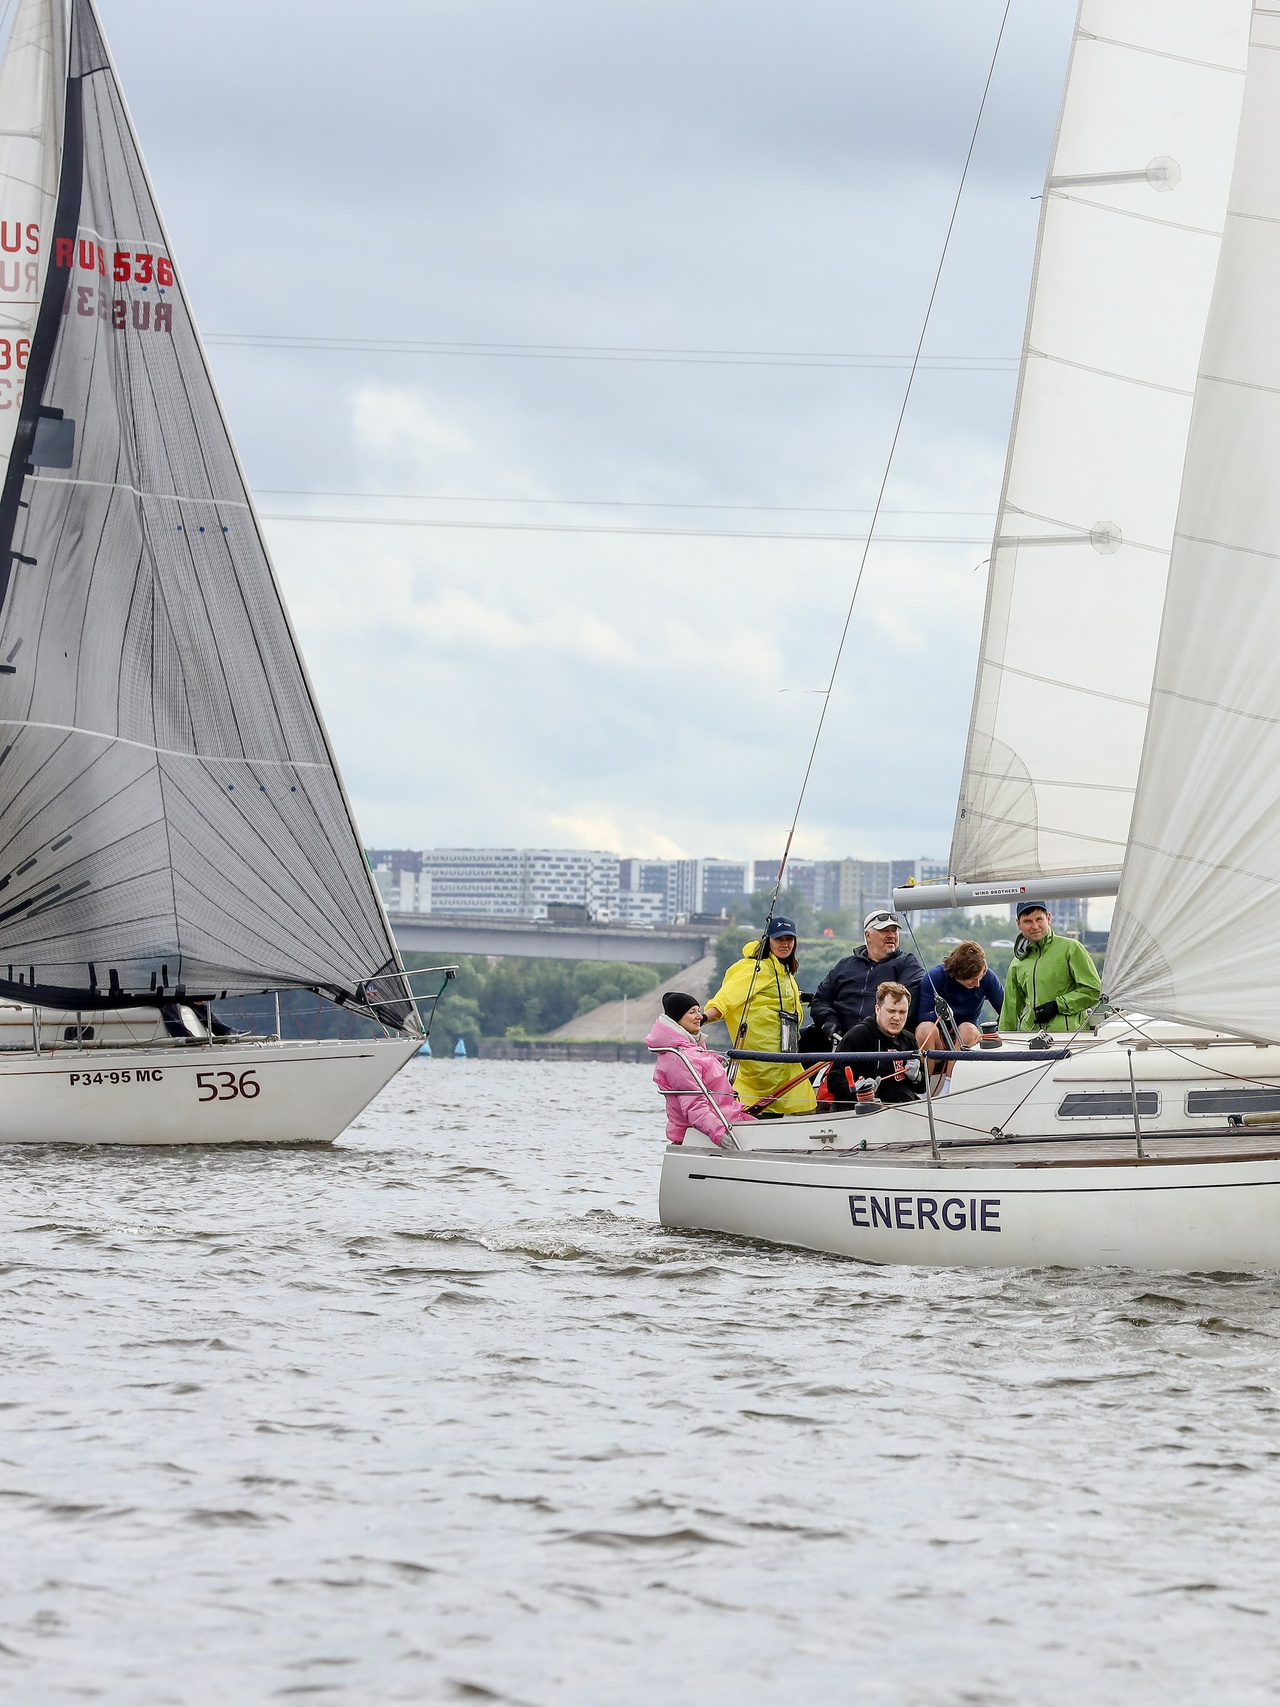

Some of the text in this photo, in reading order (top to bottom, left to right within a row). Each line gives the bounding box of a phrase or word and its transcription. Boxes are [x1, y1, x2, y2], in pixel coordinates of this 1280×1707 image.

[55, 237, 174, 287] RUS 536
[69, 1069, 164, 1086] P34-95 MC
[196, 1070, 261, 1102] 536
[848, 1195, 1002, 1233] ENERGIE
